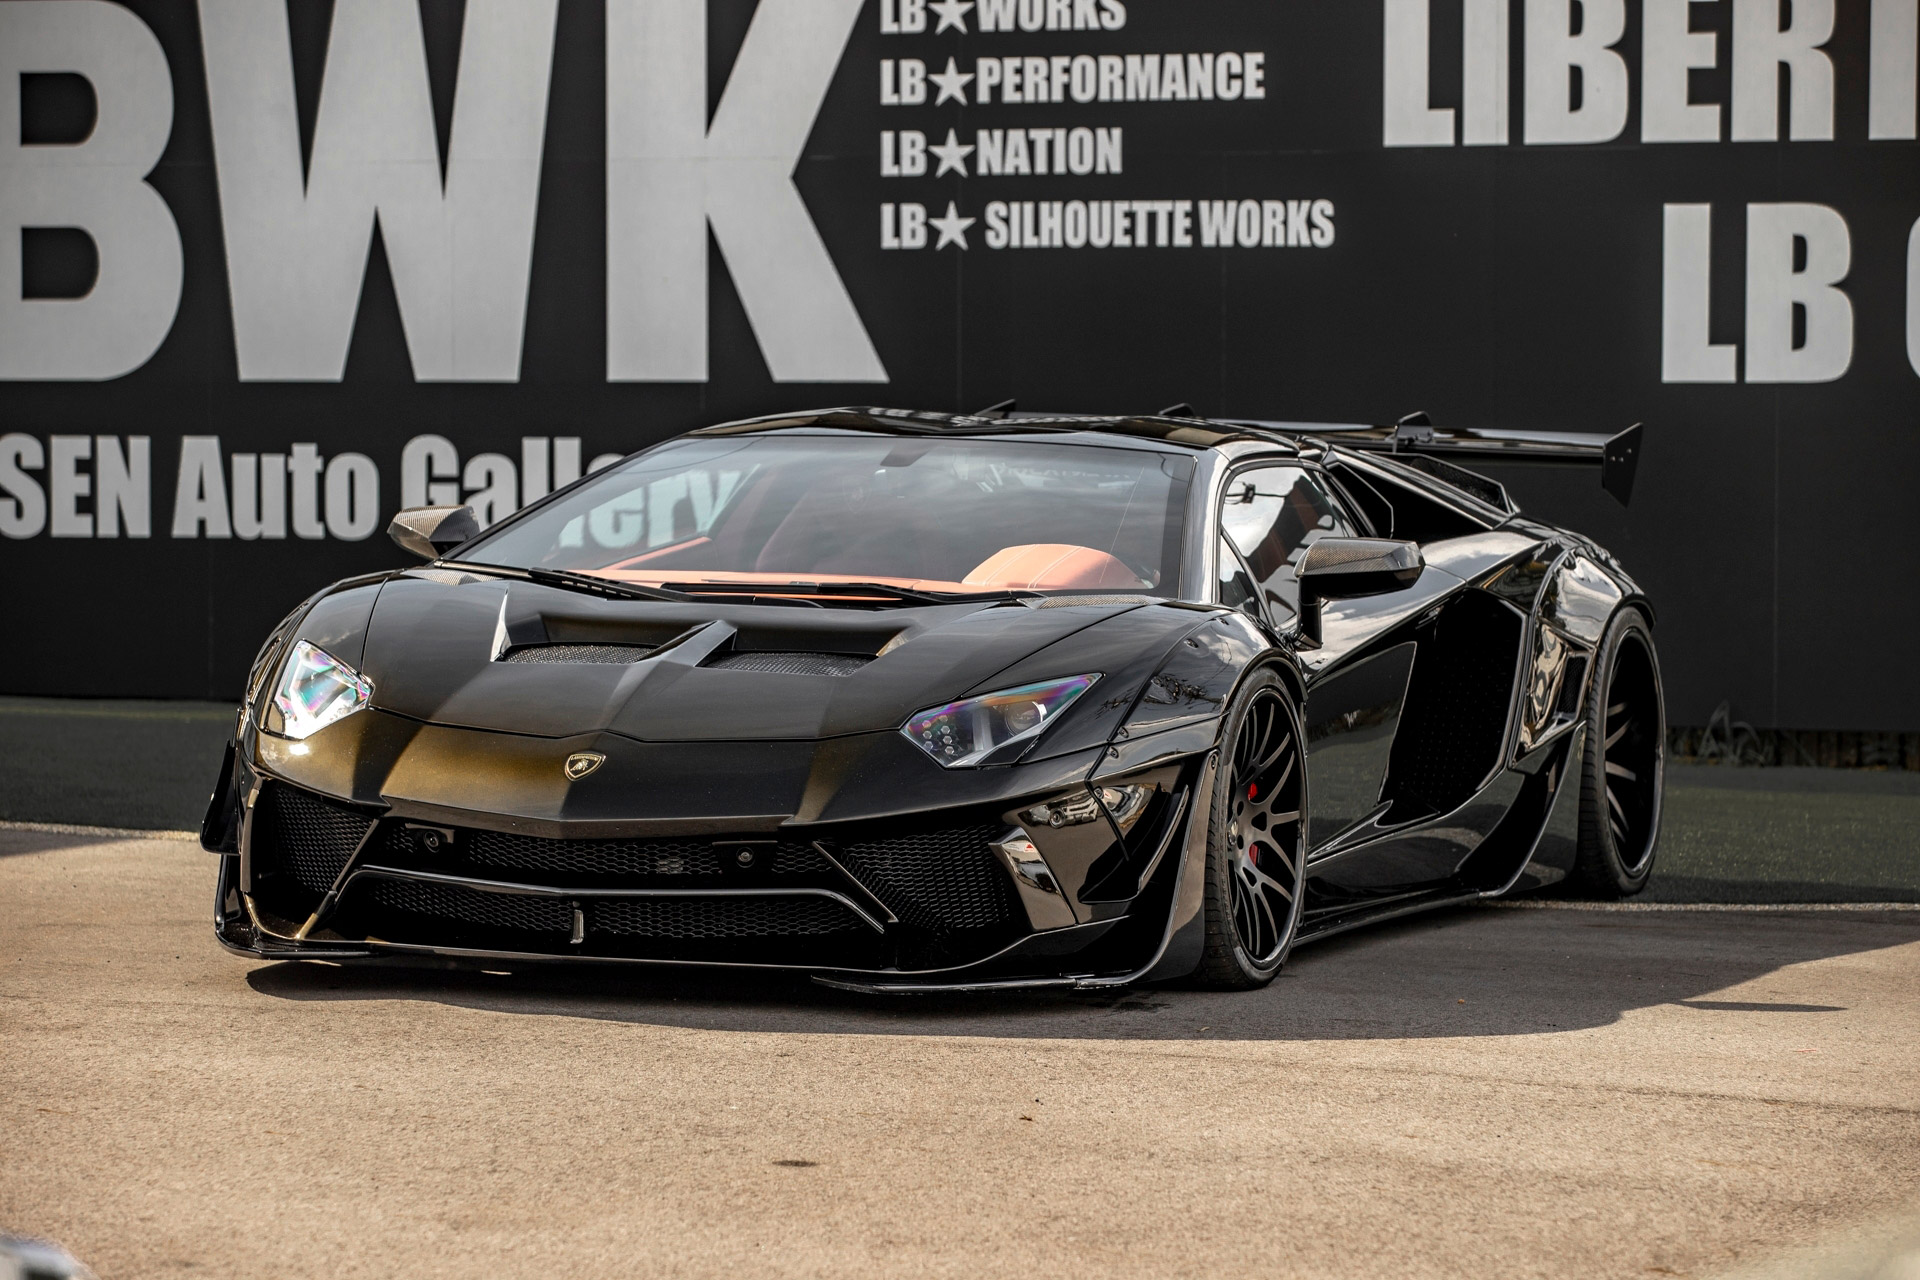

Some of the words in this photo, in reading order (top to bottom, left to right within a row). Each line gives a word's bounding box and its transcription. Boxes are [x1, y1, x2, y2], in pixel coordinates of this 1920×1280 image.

[880, 0, 927, 34] LB
[975, 0, 1127, 32] WORKS
[880, 58, 927, 105] LB
[976, 52, 1266, 104] PERFORMANCE
[880, 130, 927, 177] LB
[976, 127, 1123, 176] NATION
[0, 0, 889, 383] BWK
[880, 202, 927, 250] LB
[985, 200, 1193, 249] SILHOUETTE
[1199, 199, 1336, 248] WORKS
[1661, 202, 1854, 384] LB
[0, 433, 151, 540] SEN
[171, 435, 380, 541] Auto
